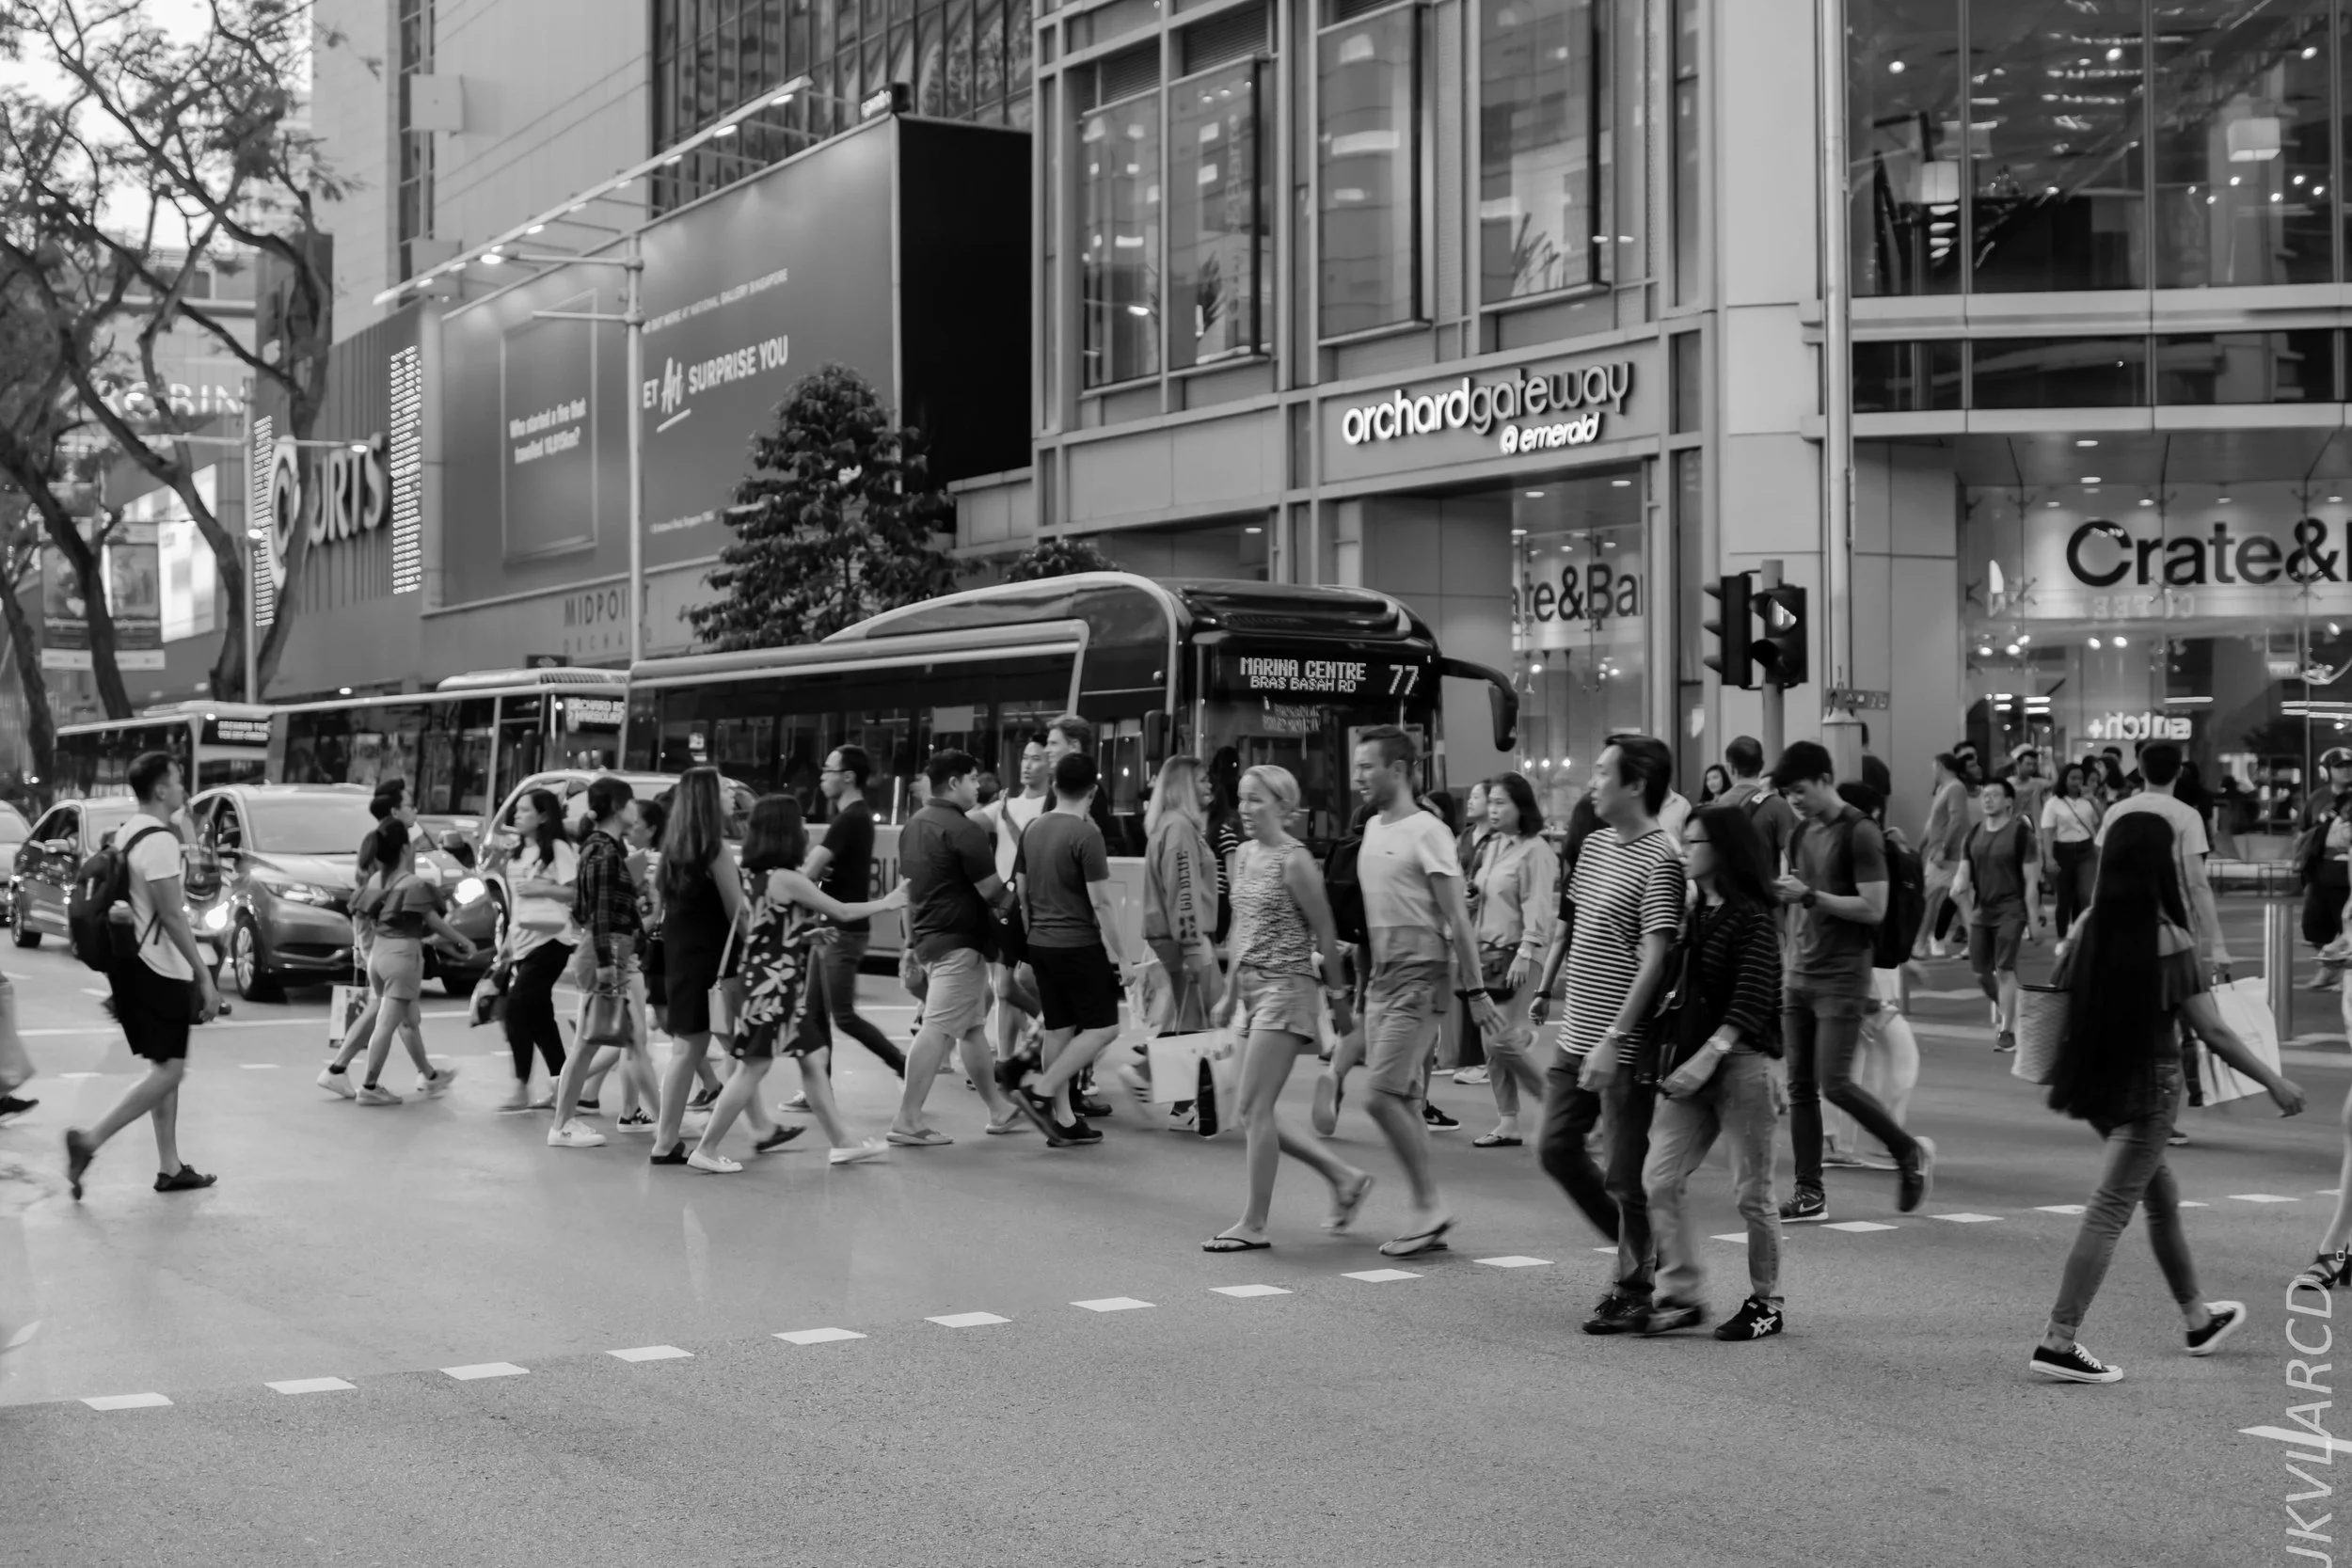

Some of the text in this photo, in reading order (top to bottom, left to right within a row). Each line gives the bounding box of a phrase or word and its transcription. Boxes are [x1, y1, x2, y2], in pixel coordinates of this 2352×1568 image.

[643, 378, 659, 408] ET
[688, 346, 756, 395] SURPRISE
[758, 335, 788, 371] YOU
[1342, 361, 1631, 445] orchardgateway
[1499, 411, 1600, 454] @emerald
[2066, 516, 2352, 587] Crate&
[564, 583, 651, 627] MIDPOIT
[1513, 562, 1644, 625] te&Ba
[563, 626, 652, 657] ORCHAD
[1239, 657, 1420, 695] MARINA CENTRE 77
[1249, 675, 1357, 693] BRAS BASAH RD
